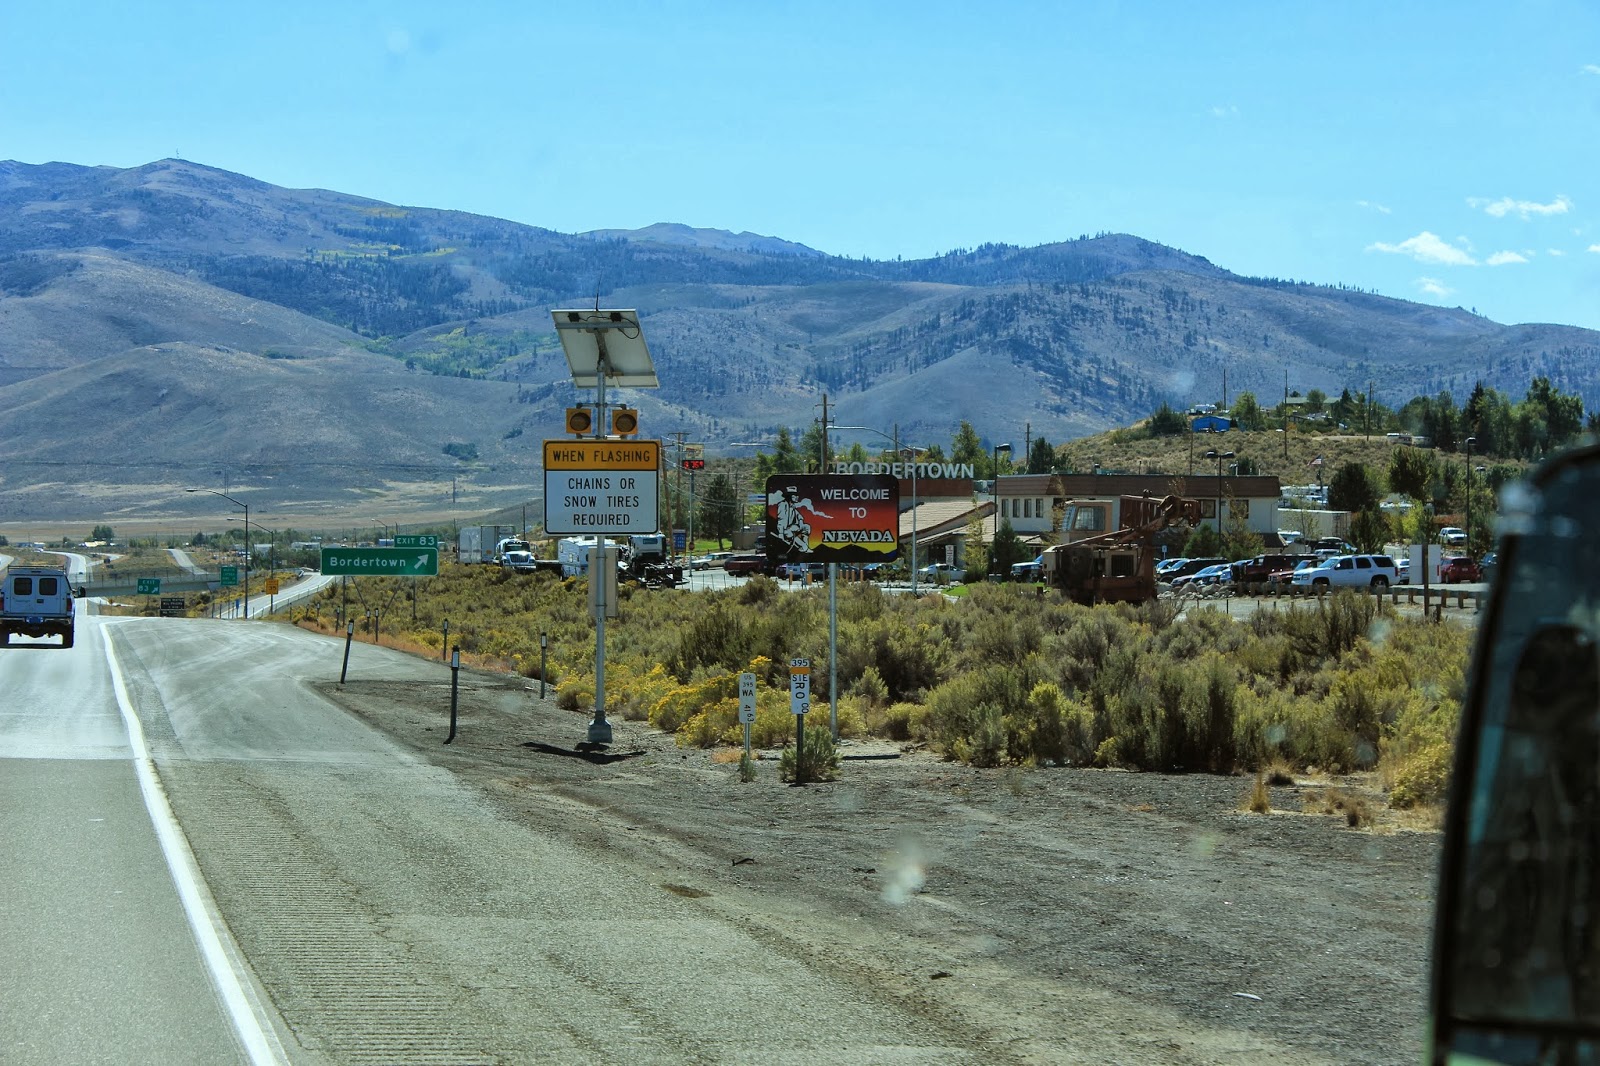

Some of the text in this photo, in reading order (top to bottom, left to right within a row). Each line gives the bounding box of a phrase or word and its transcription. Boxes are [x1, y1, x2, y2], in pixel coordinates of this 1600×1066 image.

[553, 450, 650, 462] WHEN FLASHING
[836, 462, 975, 479] BORDERTOWN
[568, 477, 635, 490] CHAINS OR
[820, 488, 890, 501] WELCOME
[564, 495, 640, 508] SNOW TIRES
[848, 506, 867, 519] TO
[573, 513, 631, 526] REQUIRED
[396, 536, 435, 546] EXIT 83
[821, 529, 894, 543] NEVADA
[329, 556, 406, 568] Bordertown
[138, 584, 149, 592] 83
[791, 659, 808, 667] 395
[792, 674, 808, 682] SIE
[742, 689, 754, 697] WA
